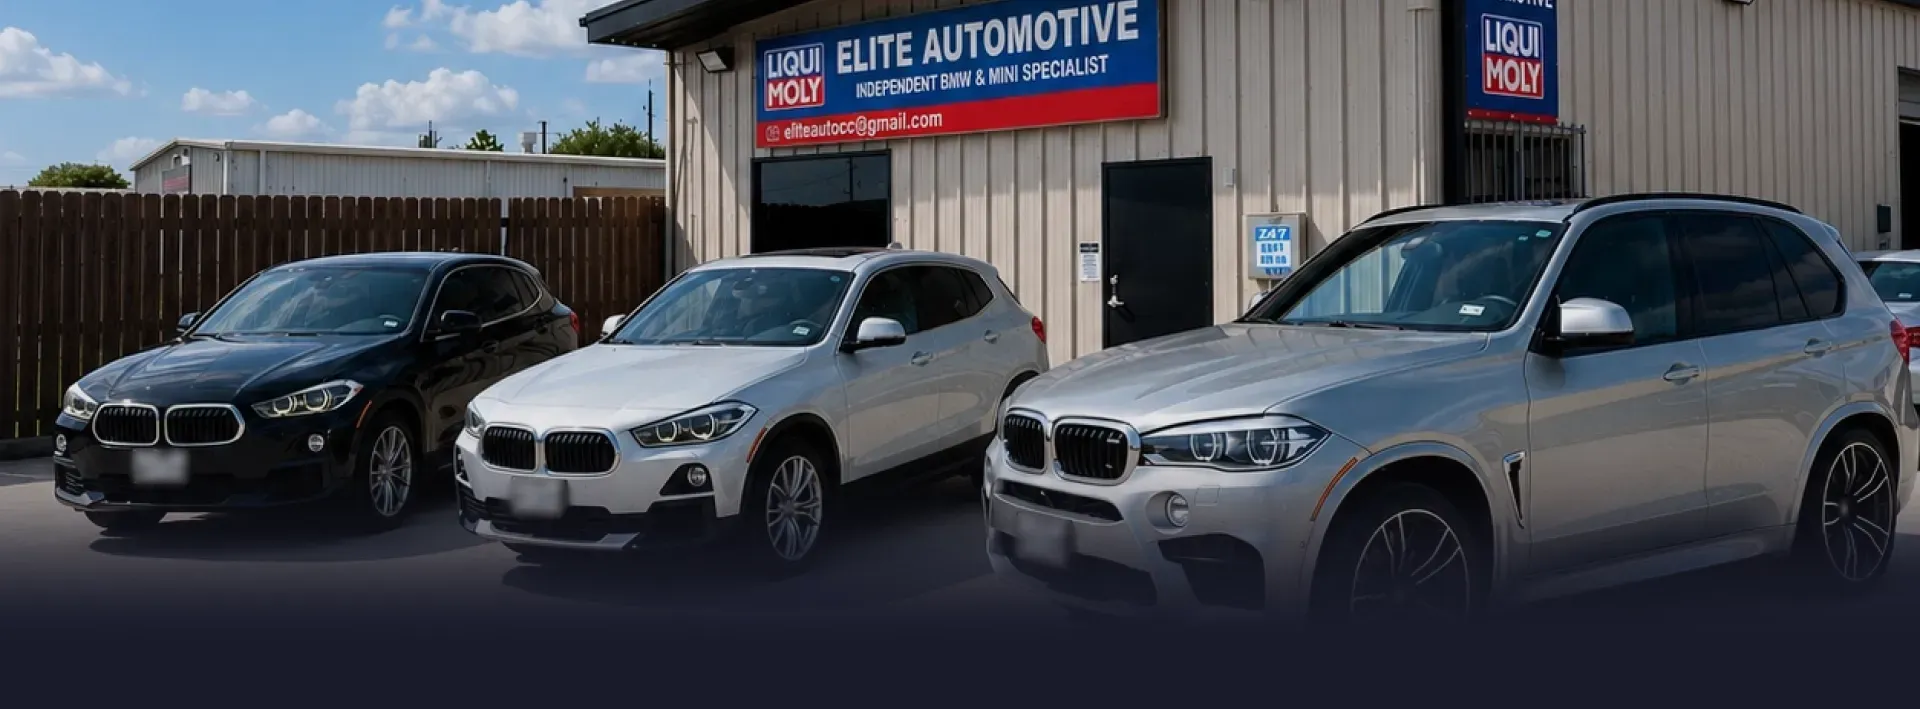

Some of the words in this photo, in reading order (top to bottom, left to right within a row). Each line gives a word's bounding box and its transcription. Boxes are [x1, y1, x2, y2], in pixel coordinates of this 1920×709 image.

[837, 31, 913, 74] ELITE
[922, 0, 1139, 65] AUTOMOTIVE
[1485, 19, 1539, 57] LIQUI
[768, 47, 820, 79] LIQUI
[856, 74, 938, 99] INDEPENDENT
[940, 70, 972, 90] BMW
[976, 69, 986, 86] &
[989, 64, 1019, 86] MINI
[1022, 54, 1109, 82] SPECIALIST
[1486, 57, 1541, 94] MOLY
[768, 76, 822, 107] MOLY
